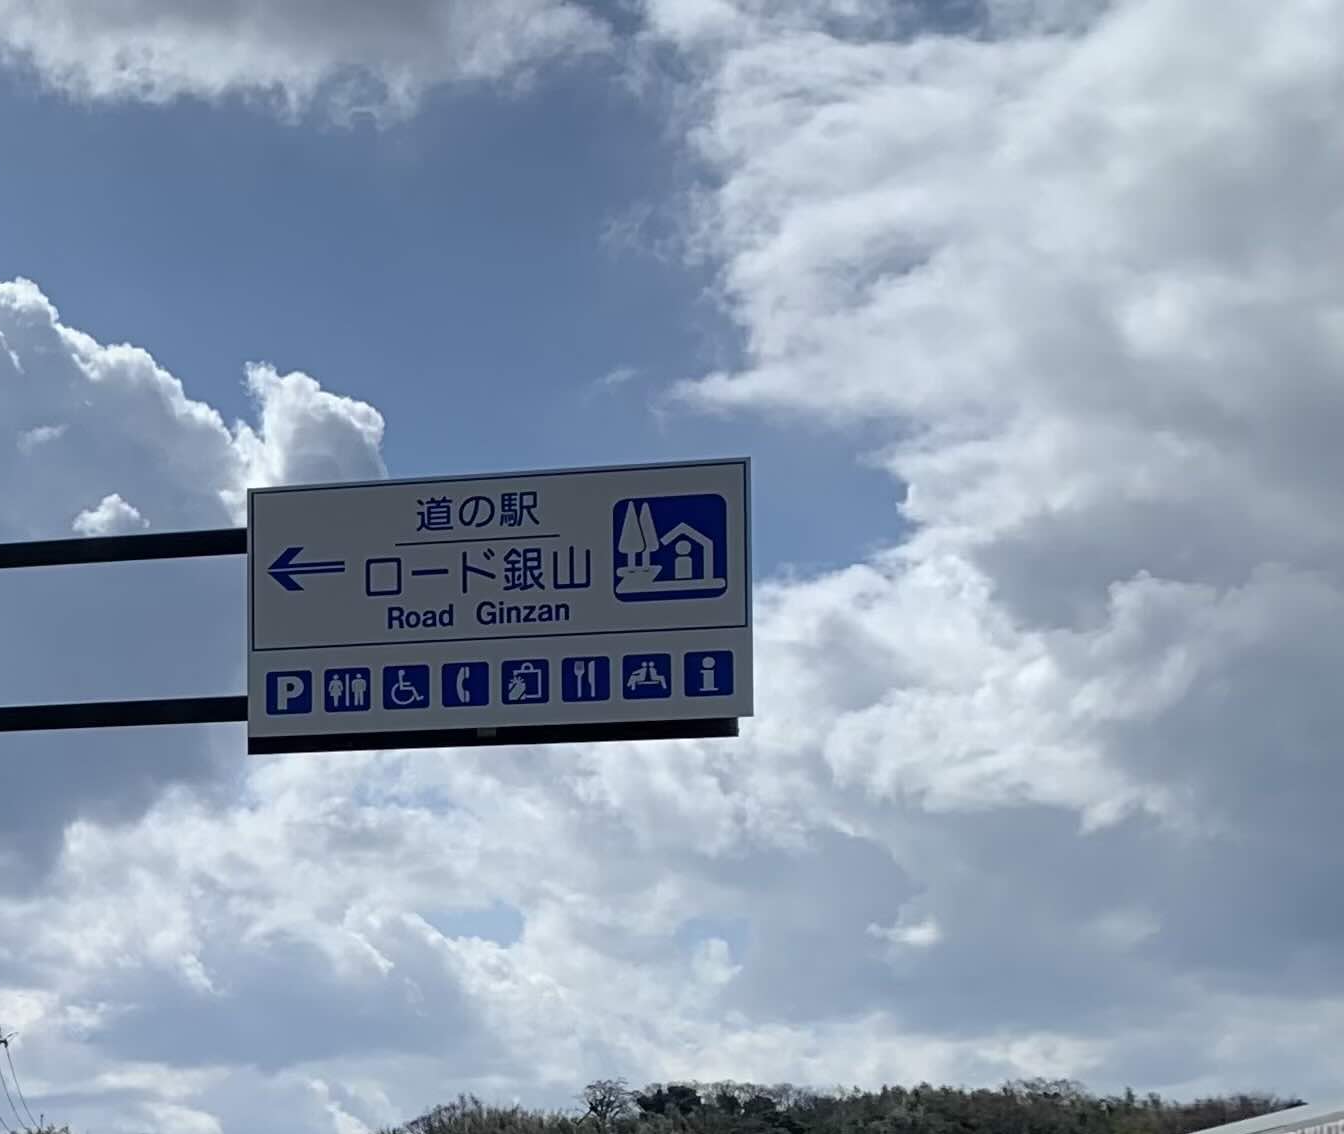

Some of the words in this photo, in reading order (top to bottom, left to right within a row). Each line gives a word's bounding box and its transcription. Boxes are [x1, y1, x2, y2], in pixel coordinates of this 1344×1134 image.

[416, 491, 540, 533] 道の駅
[364, 545, 592, 597] ロード銀山
[386, 603, 454, 630] Road
[475, 600, 571, 626] Ginzan
